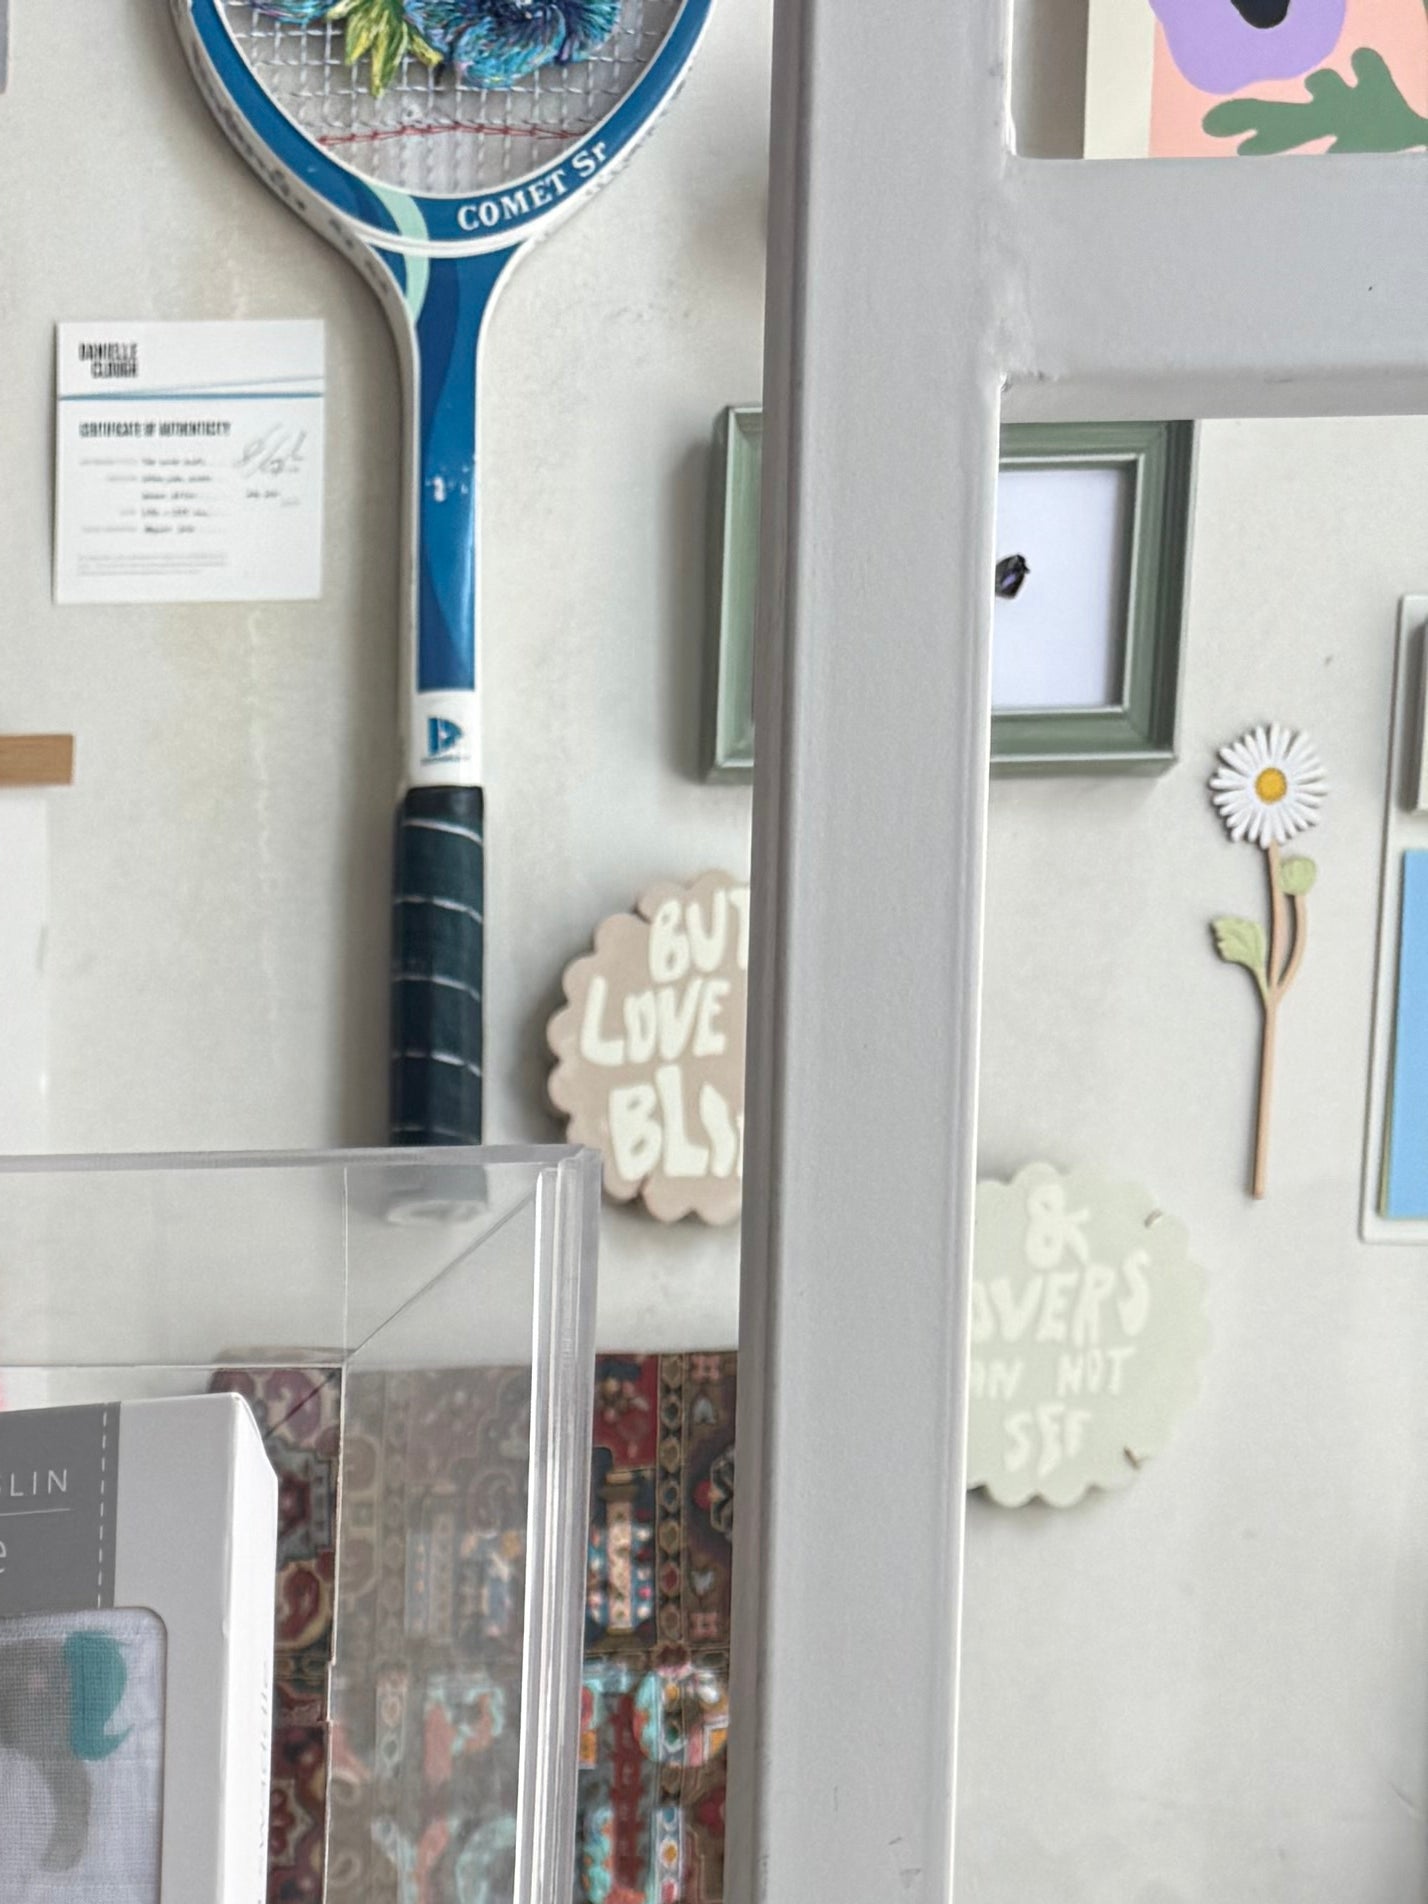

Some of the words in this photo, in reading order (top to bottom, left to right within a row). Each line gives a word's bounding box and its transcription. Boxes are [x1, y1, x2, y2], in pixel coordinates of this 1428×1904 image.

[456, 170, 568, 231] COMET
[571, 141, 607, 178] Sr
[579, 975, 732, 1067] LOVE
[1025, 1183, 1091, 1270] &
[1055, 1346, 1137, 1398] NOT
